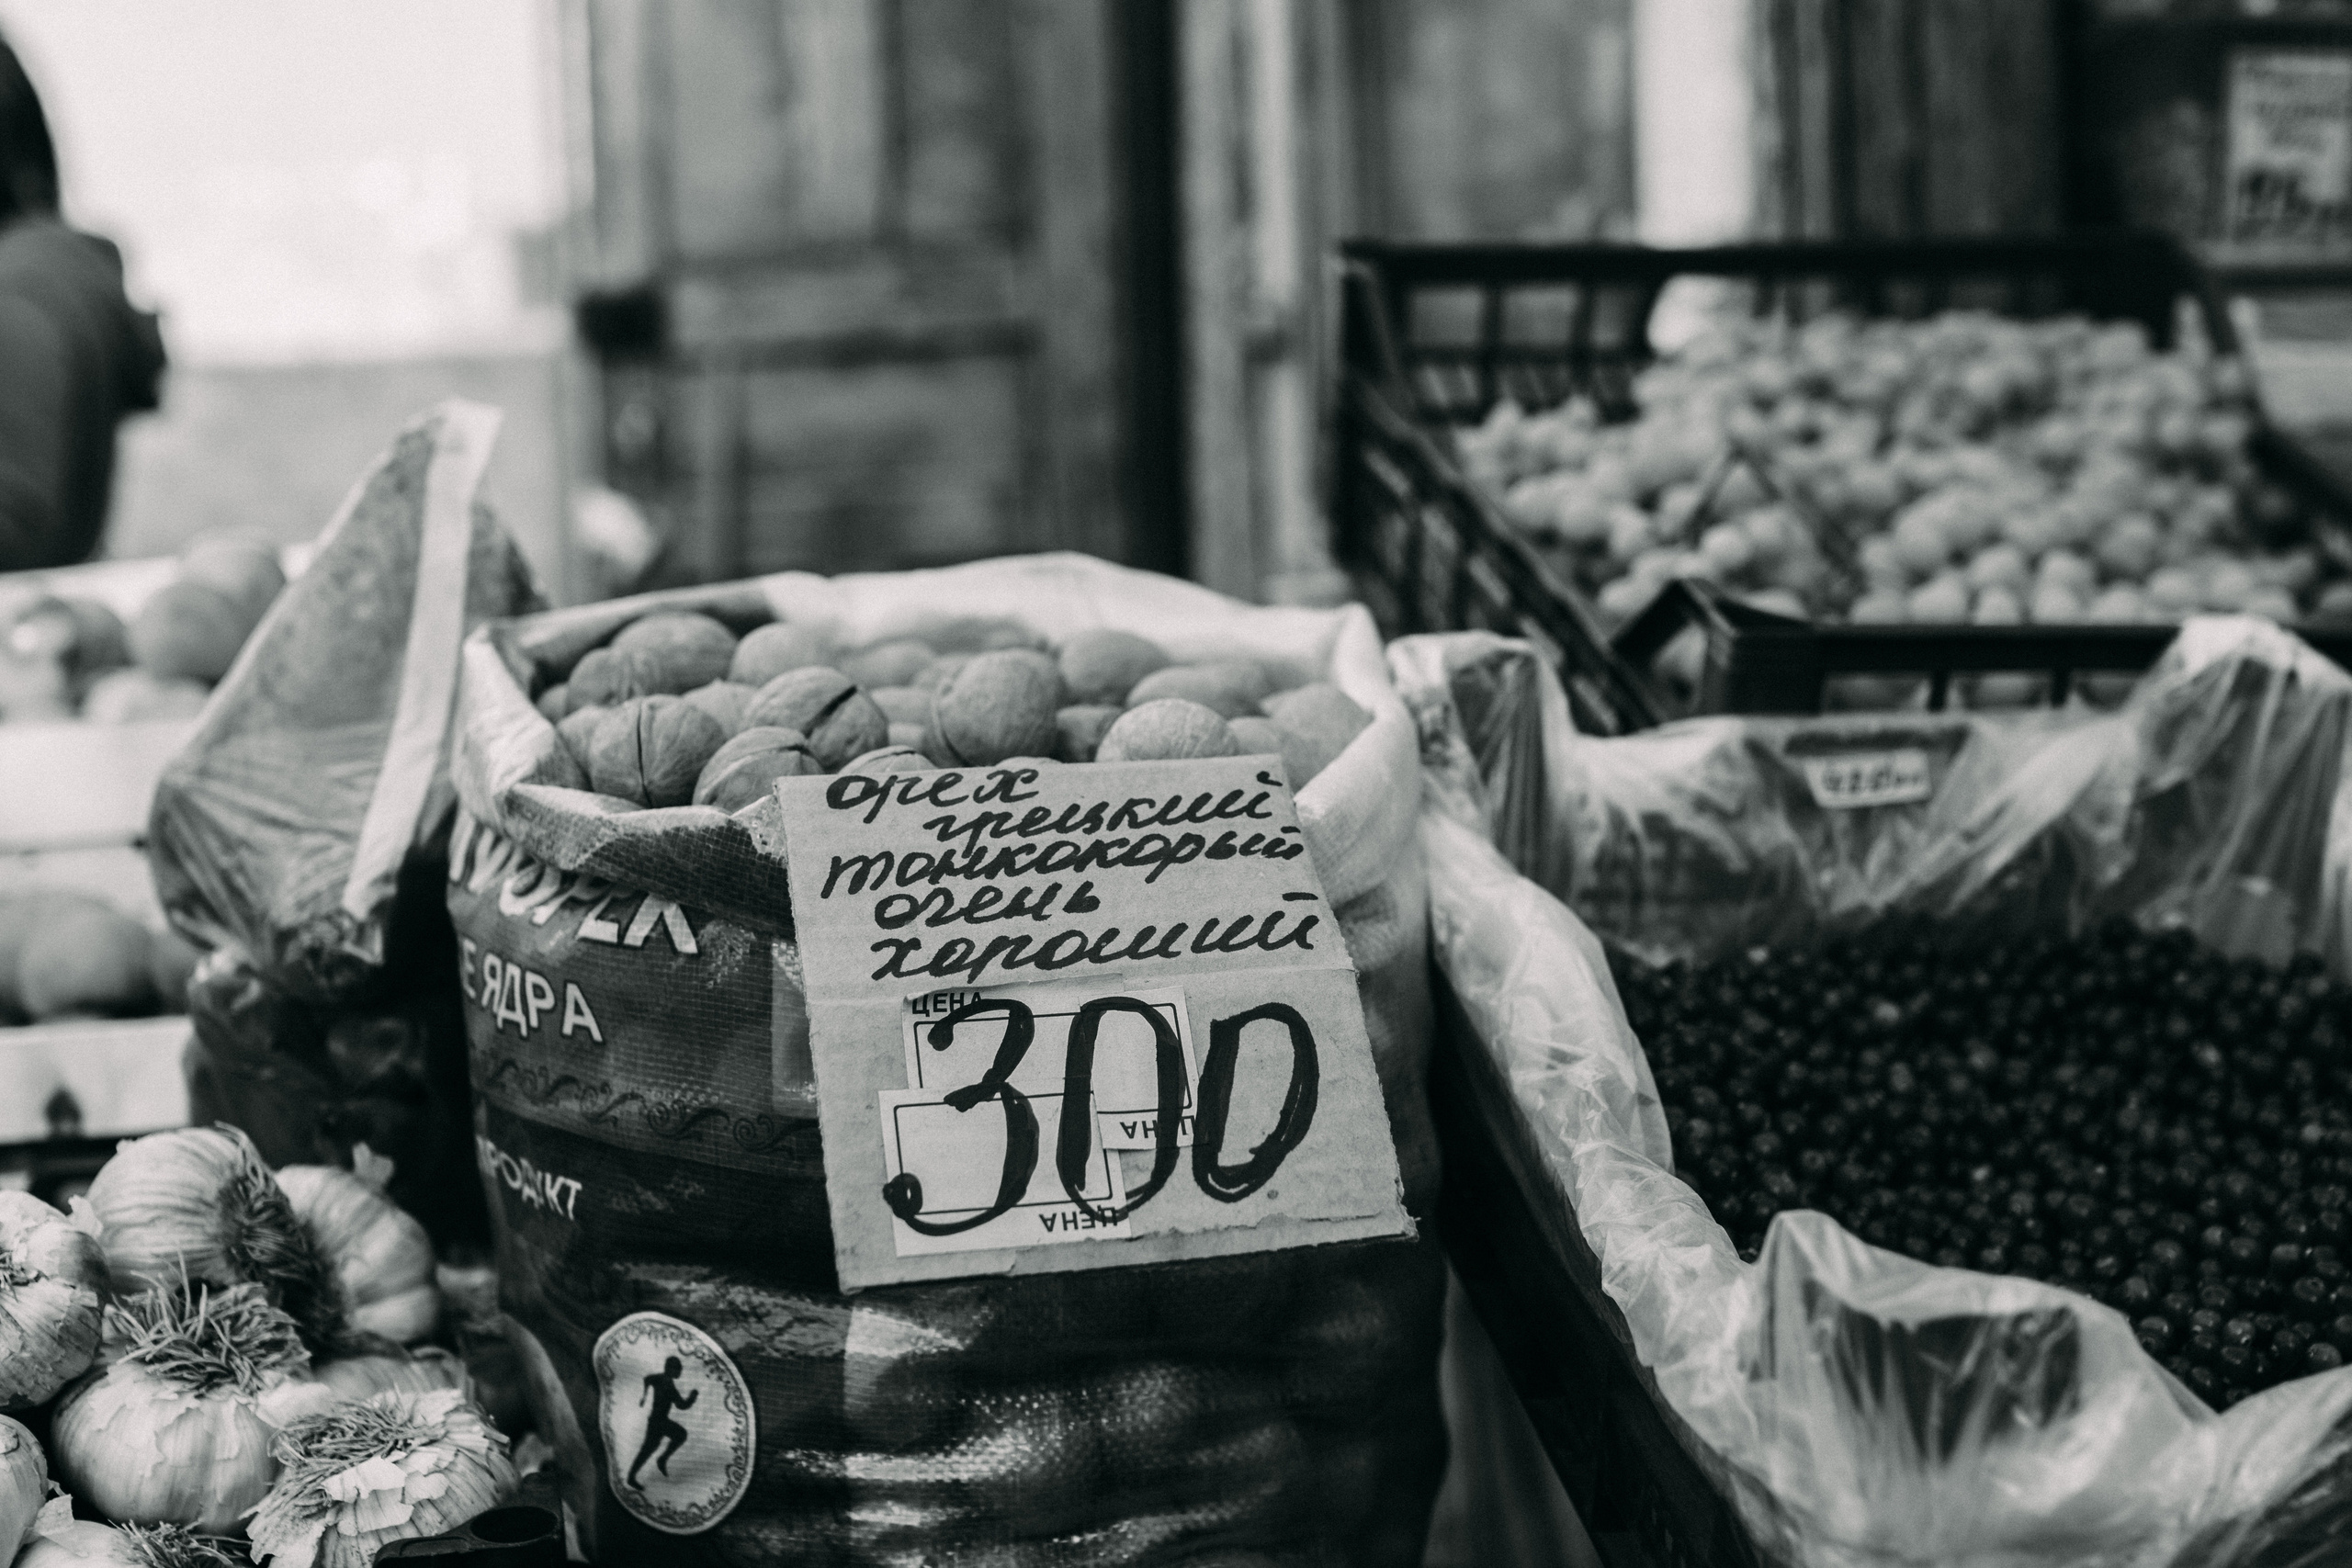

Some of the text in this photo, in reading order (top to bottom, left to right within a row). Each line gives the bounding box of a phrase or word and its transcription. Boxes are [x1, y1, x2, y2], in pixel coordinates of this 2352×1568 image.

[827, 769, 1039, 823] орех
[922, 770, 1283, 856] грецкий
[821, 826, 1304, 898] тонкокорый
[871, 892, 1318, 984] хороший
[875, 880, 1102, 931] очень
[481, 952, 604, 1043] ЯДРА
[912, 992, 983, 1017] ЦЕНА
[882, 997, 1319, 1236] 300
[1120, 1115, 1195, 1139] ЦНА
